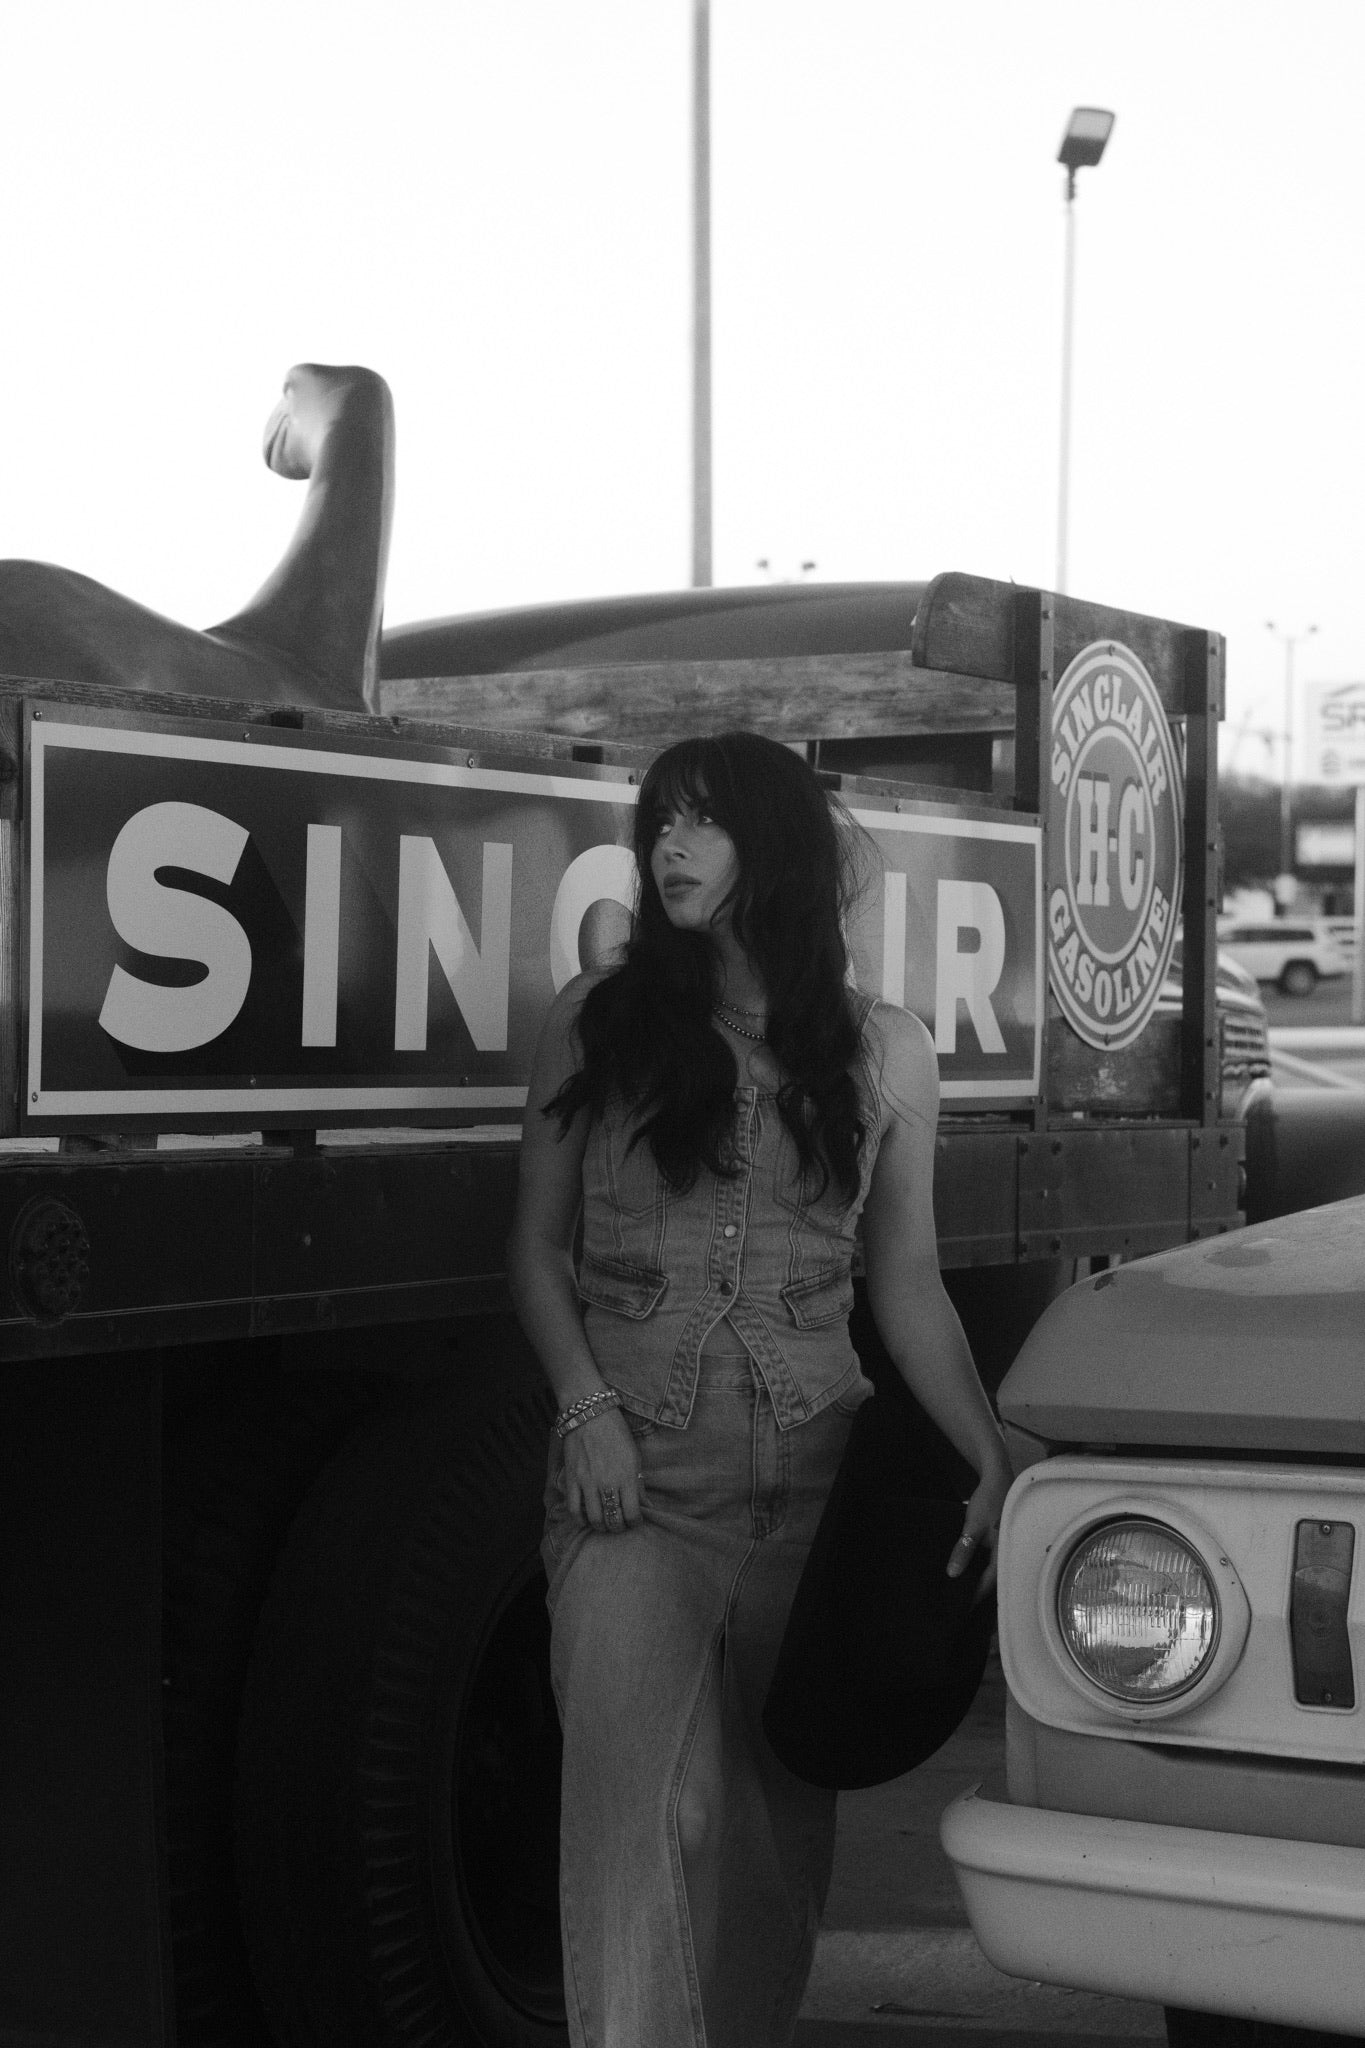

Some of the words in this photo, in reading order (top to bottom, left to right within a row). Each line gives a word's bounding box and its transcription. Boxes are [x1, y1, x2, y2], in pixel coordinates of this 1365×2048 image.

[1051, 674, 1168, 806] SINCLAIR
[98, 801, 1007, 1054] SINIR
[1050, 886, 1170, 1018] GASOLINE
